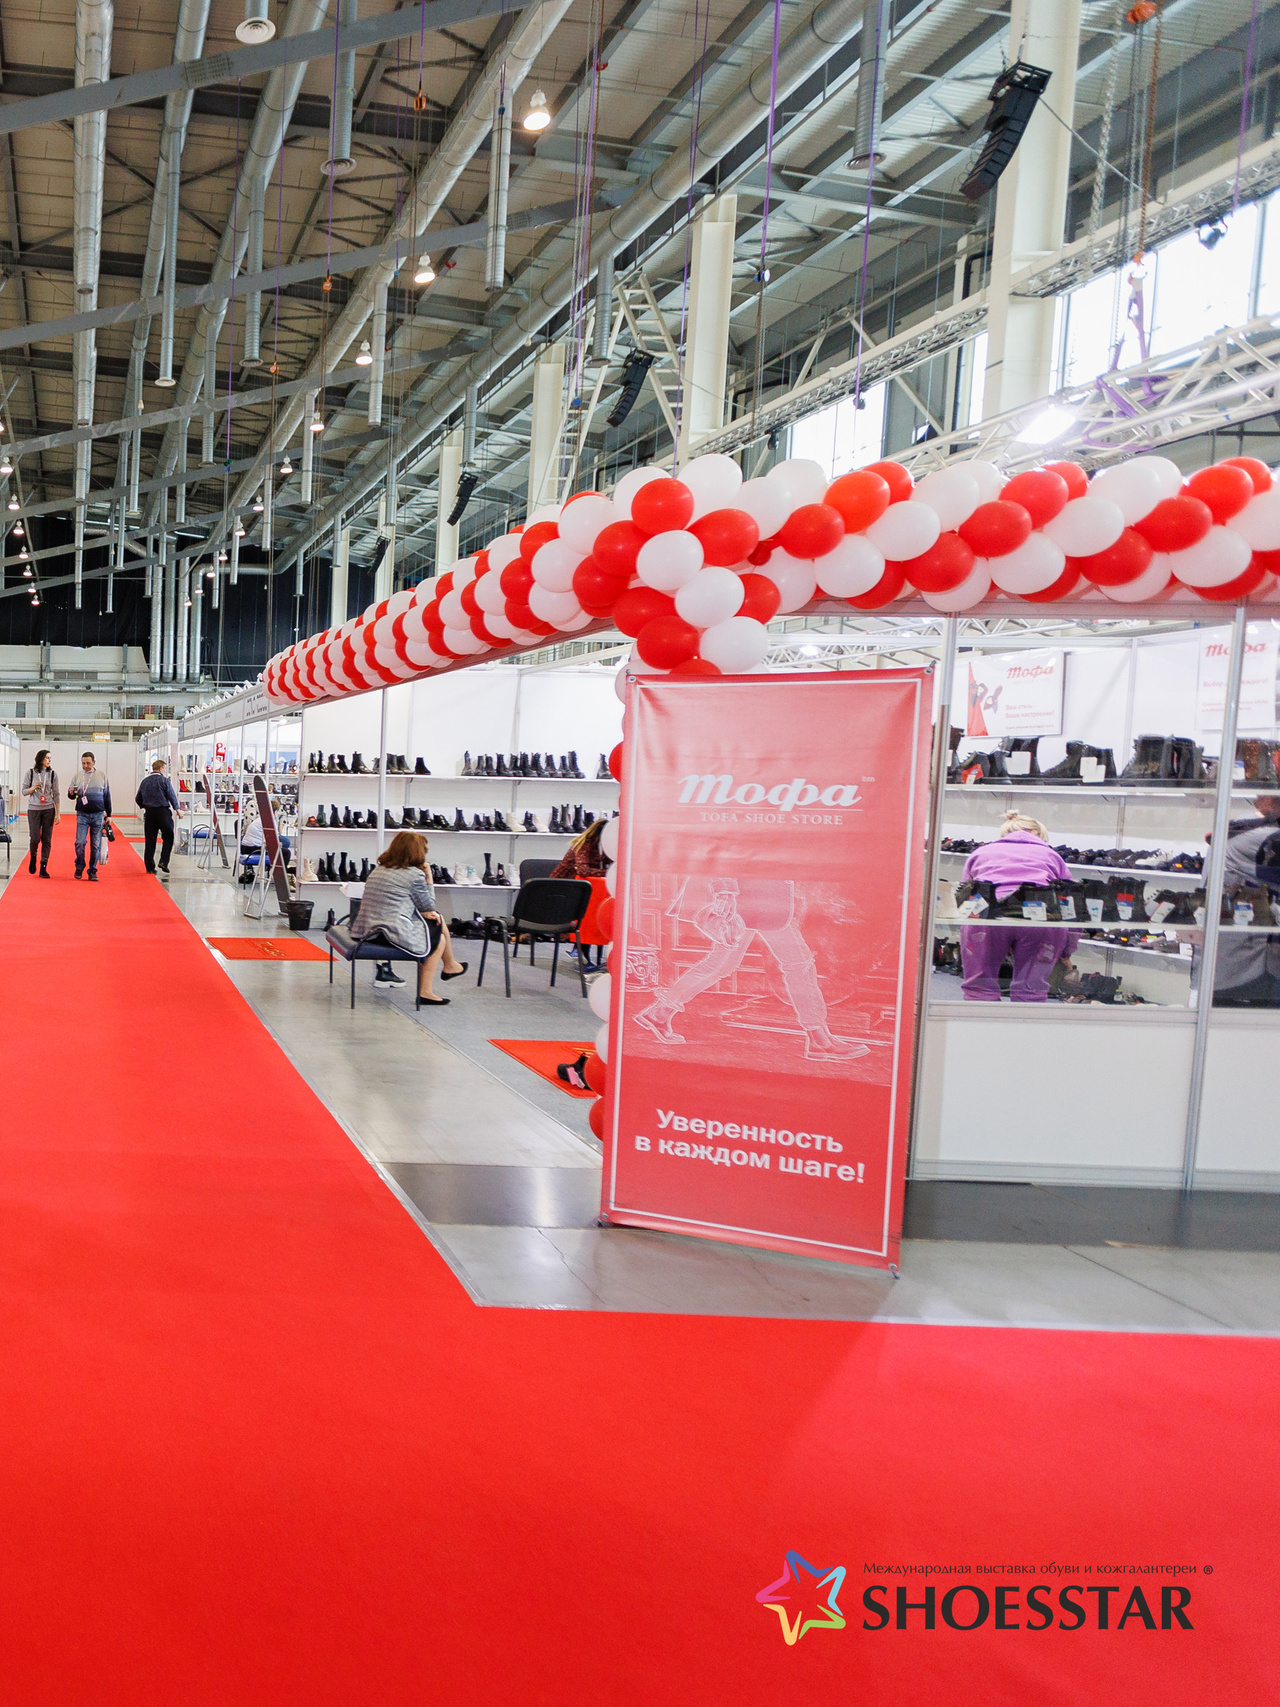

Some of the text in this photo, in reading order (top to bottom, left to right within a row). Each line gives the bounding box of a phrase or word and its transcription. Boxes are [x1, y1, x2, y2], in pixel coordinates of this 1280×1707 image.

[678, 773, 863, 812] Тофа
[744, 813, 786, 825] SHOE
[792, 814, 844, 826] STORE
[656, 1108, 844, 1153] Уверенность
[634, 1135, 866, 1184] в каждом шаге!
